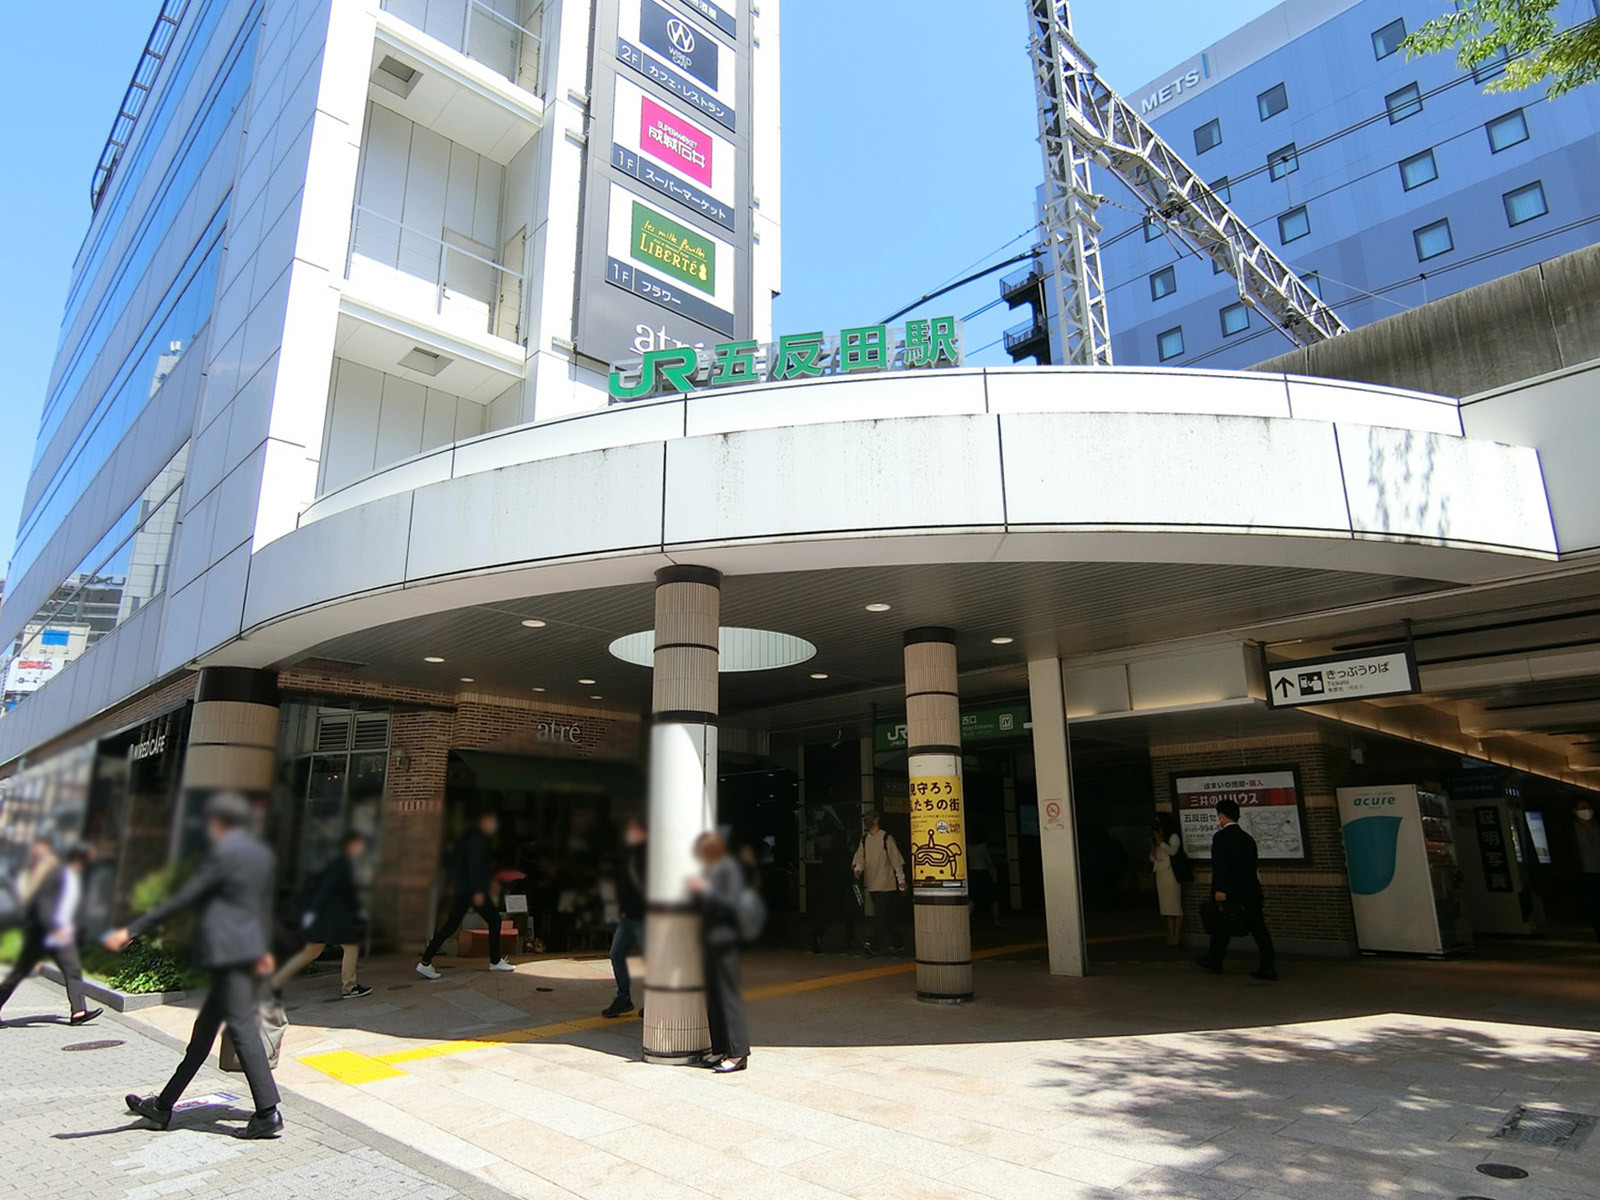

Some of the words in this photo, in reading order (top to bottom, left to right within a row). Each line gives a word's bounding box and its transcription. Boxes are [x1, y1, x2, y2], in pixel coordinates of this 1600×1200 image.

[621, 45, 638, 65] 2F
[649, 65, 725, 117] カフェ・レストラン
[1141, 68, 1201, 115] METS
[648, 125, 706, 169] 成城石井
[657, 121, 698, 150] SUPERMARKET
[618, 150, 634, 169] 1F
[645, 168, 726, 219] スーパーマーケット
[613, 263, 629, 283] 1F
[641, 280, 682, 305] フラワー
[1326, 661, 1390, 680] きっぷうりば
[537, 720, 581, 743] atré
[1353, 796, 1396, 806] acure
